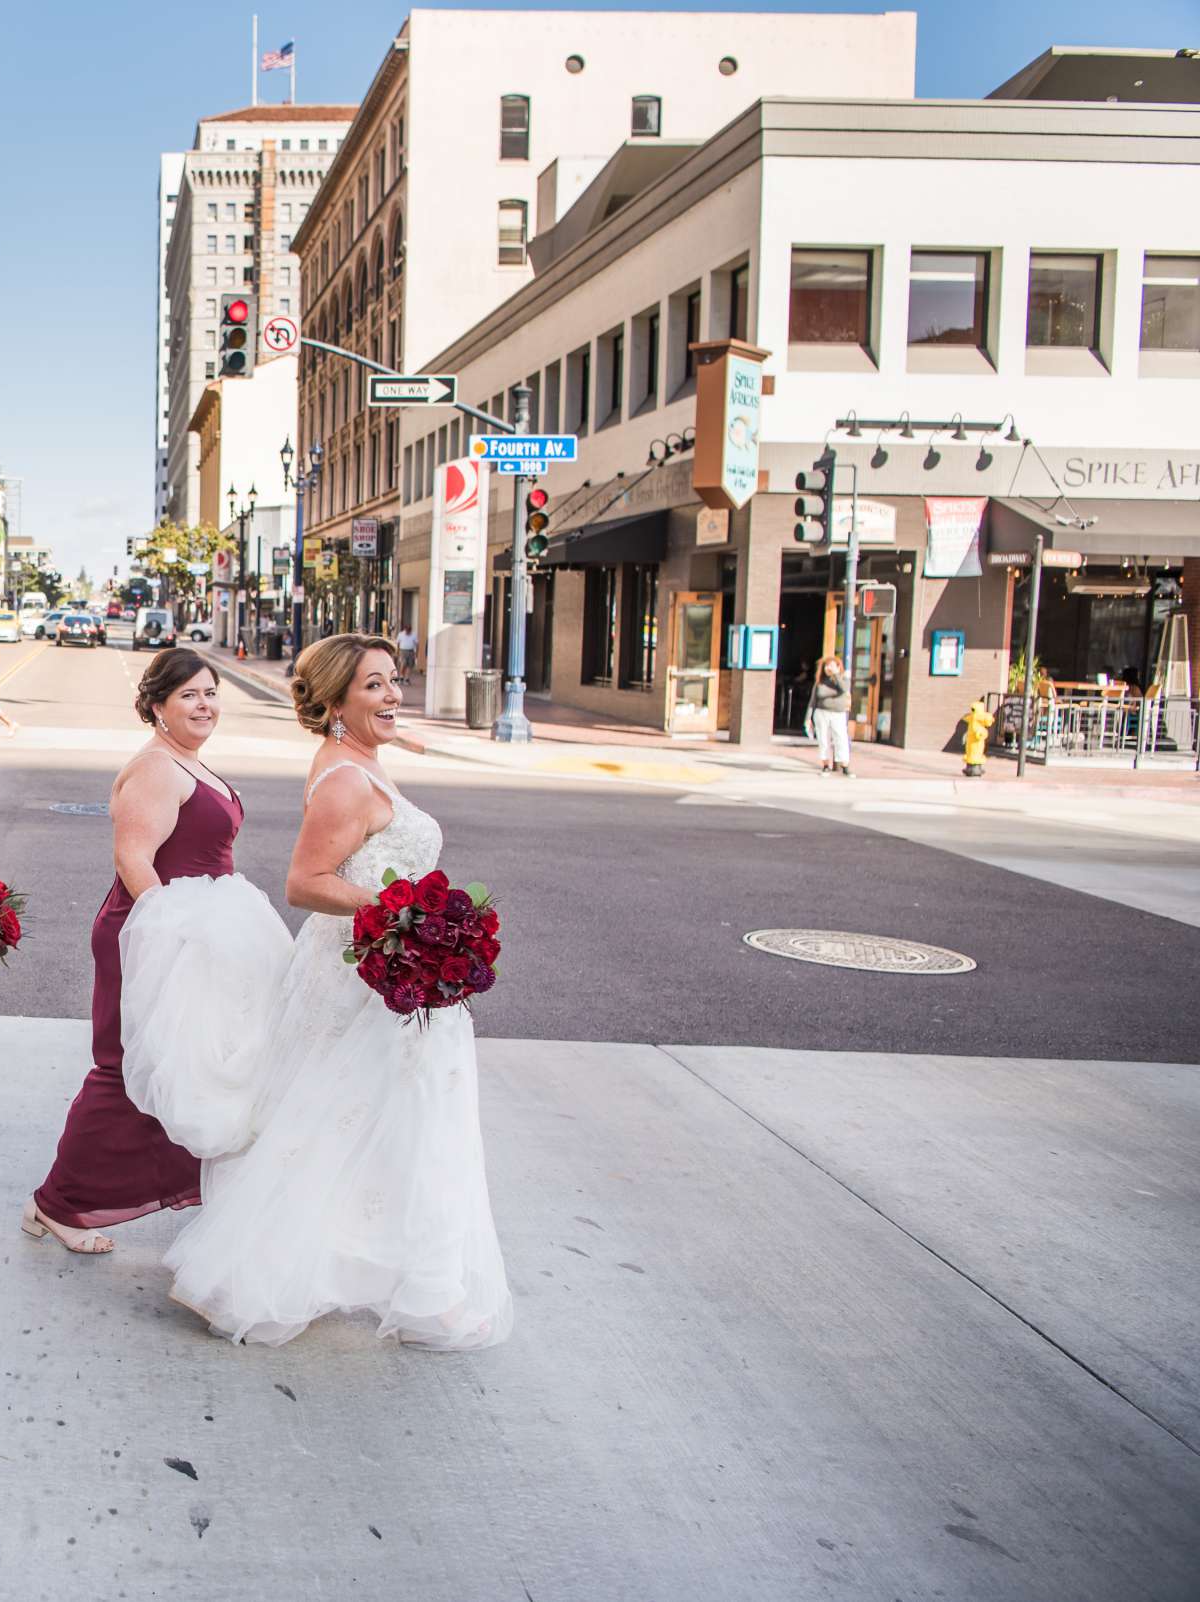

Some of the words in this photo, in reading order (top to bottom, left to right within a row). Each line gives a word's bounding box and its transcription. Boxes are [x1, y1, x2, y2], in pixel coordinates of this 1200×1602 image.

[383, 385, 402, 395] ONE
[408, 385, 429, 395] WAY
[490, 440, 540, 456] FOURTH
[544, 440, 567, 456] AV.
[1063, 457, 1147, 488] SPIKE
[991, 553, 1026, 564] BROADWAY
